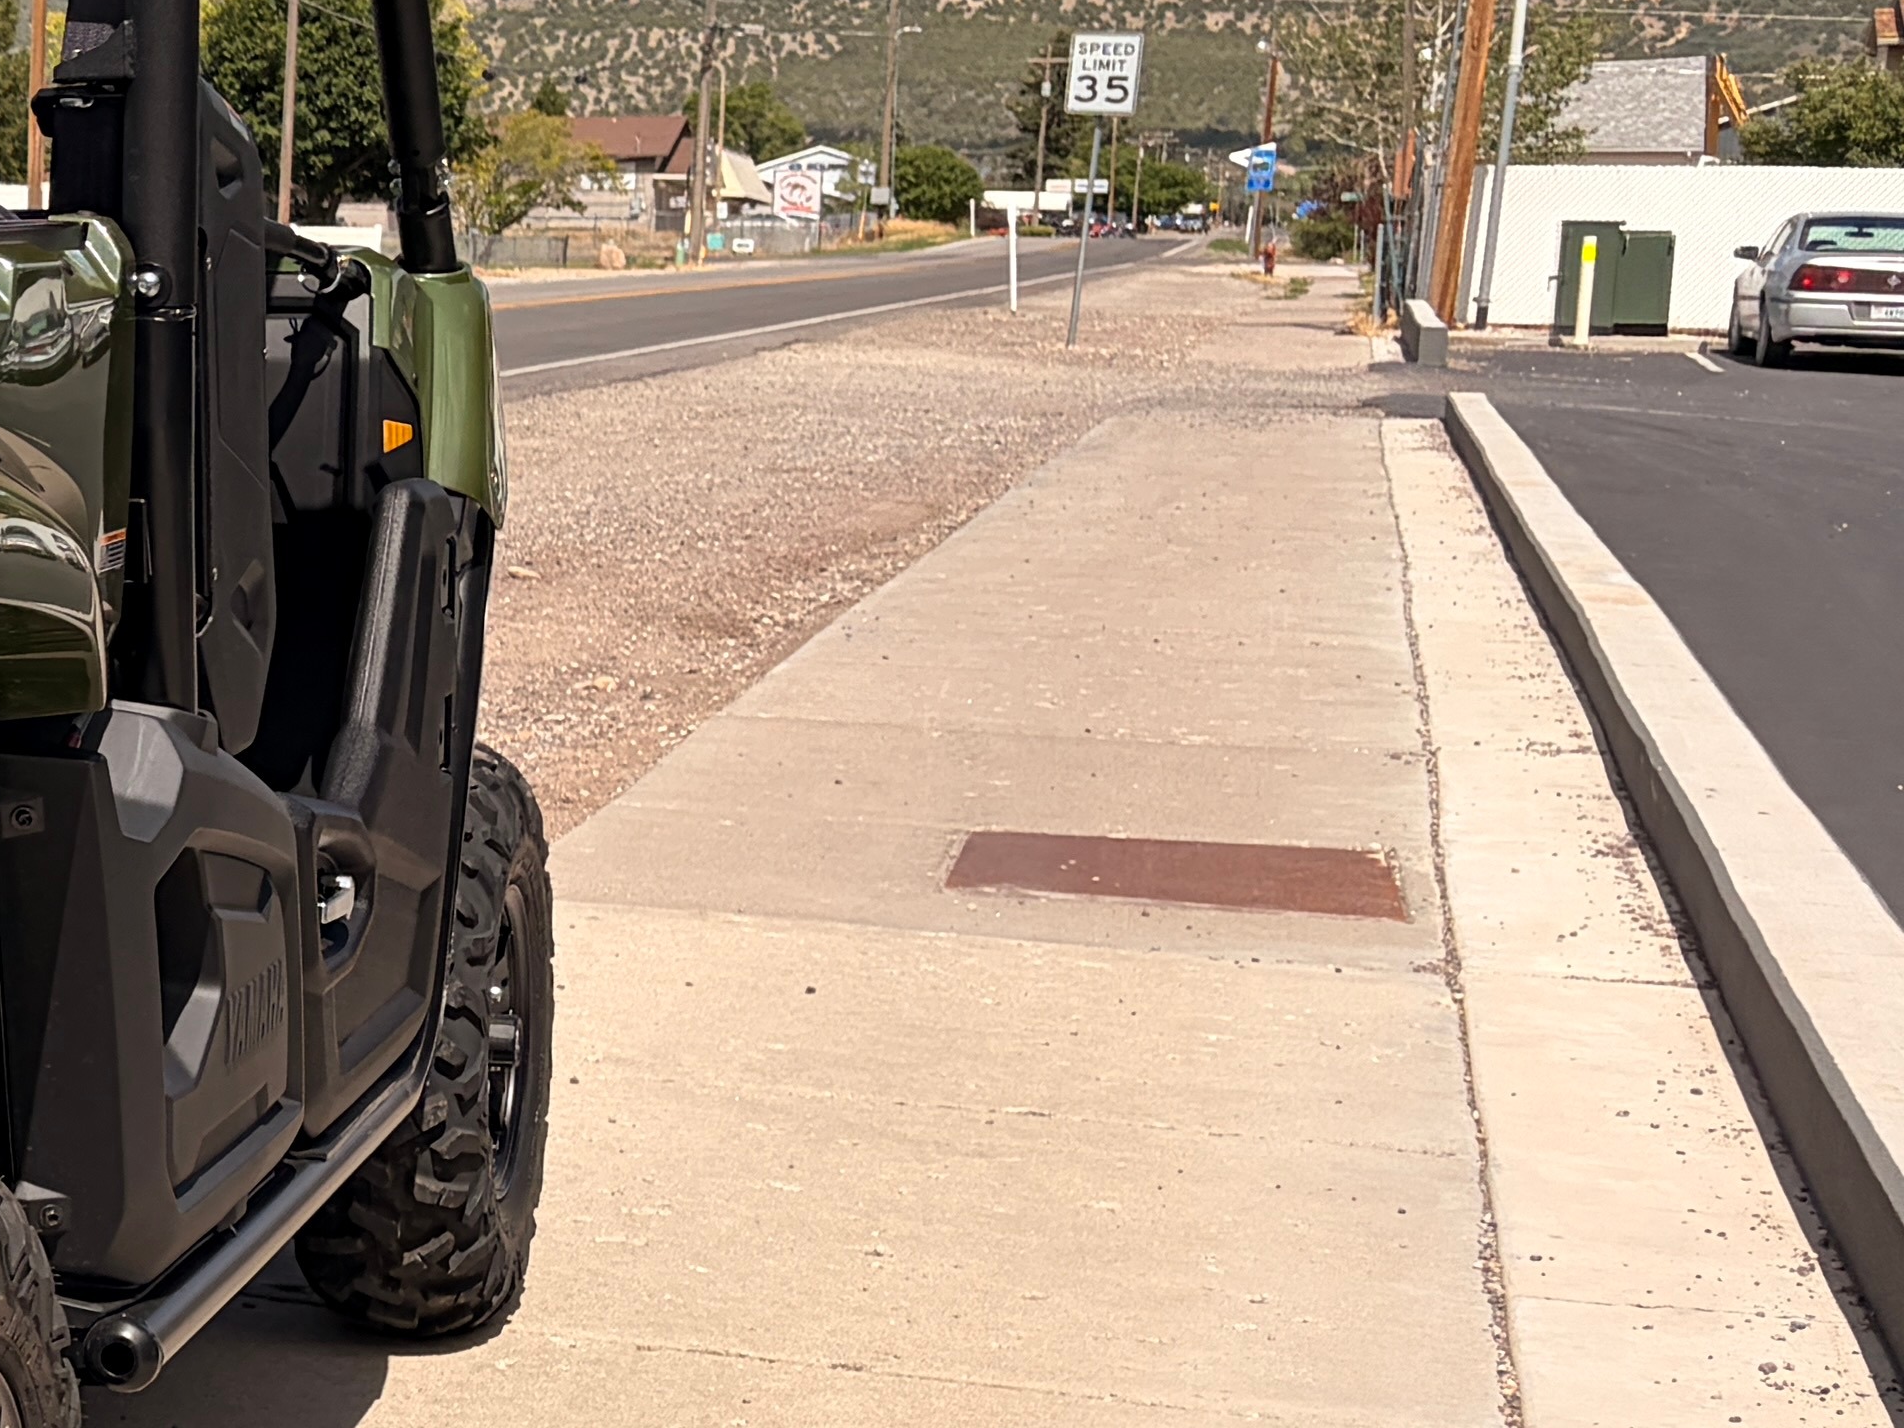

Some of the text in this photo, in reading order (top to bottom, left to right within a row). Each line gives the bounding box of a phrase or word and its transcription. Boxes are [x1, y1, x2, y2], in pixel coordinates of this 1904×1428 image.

[1078, 42, 1135, 56] SPEED
[1082, 59, 1127, 72] LIMIT
[1074, 75, 1129, 104] 35
